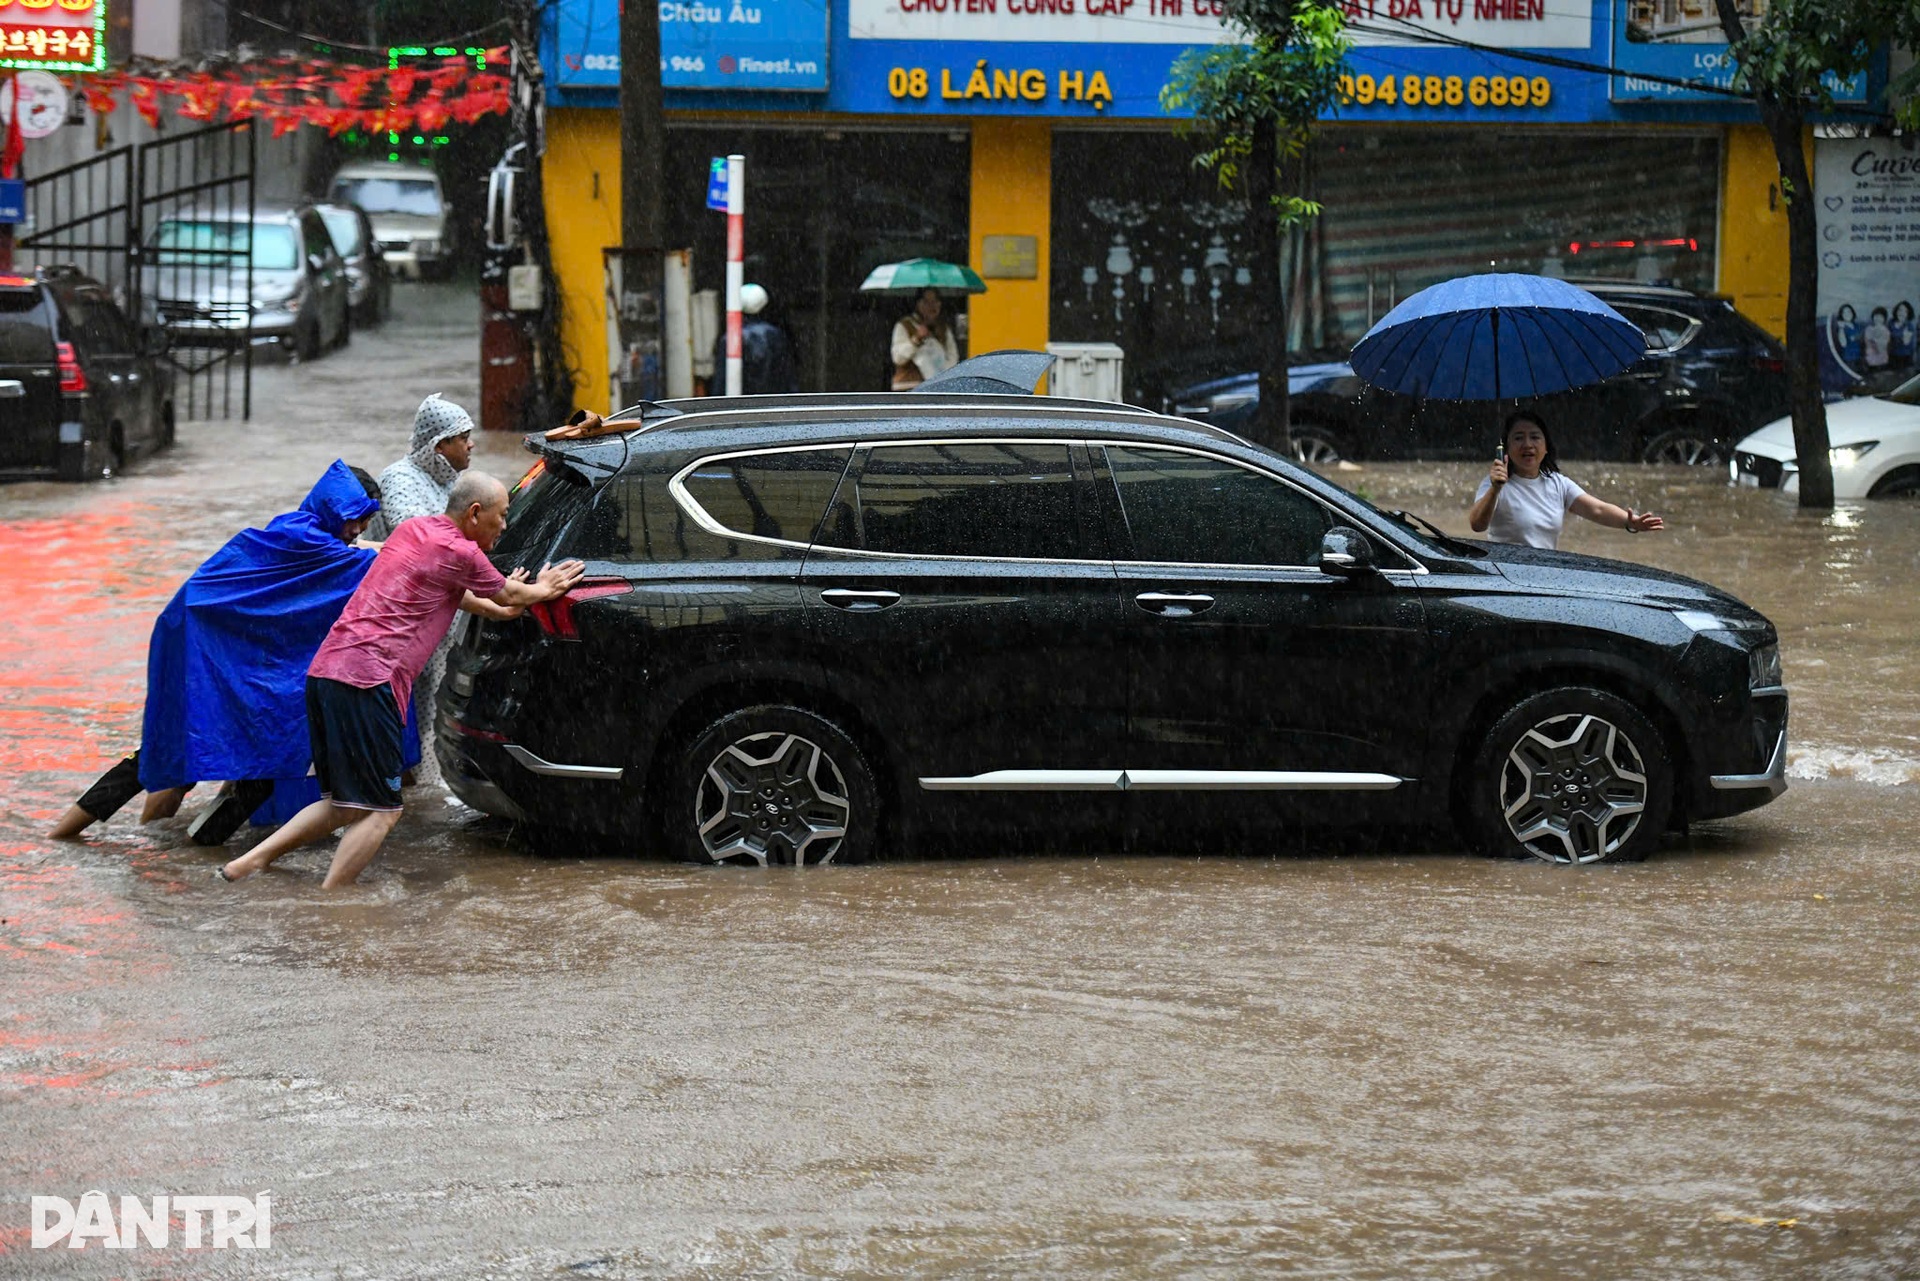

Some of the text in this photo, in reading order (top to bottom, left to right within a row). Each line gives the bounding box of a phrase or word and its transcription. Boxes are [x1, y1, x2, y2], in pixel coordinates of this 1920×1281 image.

[658, 0, 762, 24] Châu Âu
[671, 56, 705, 72] 966
[739, 57, 818, 75] Finest.vn
[888, 59, 1113, 110] 08 LÁNG HẠ
